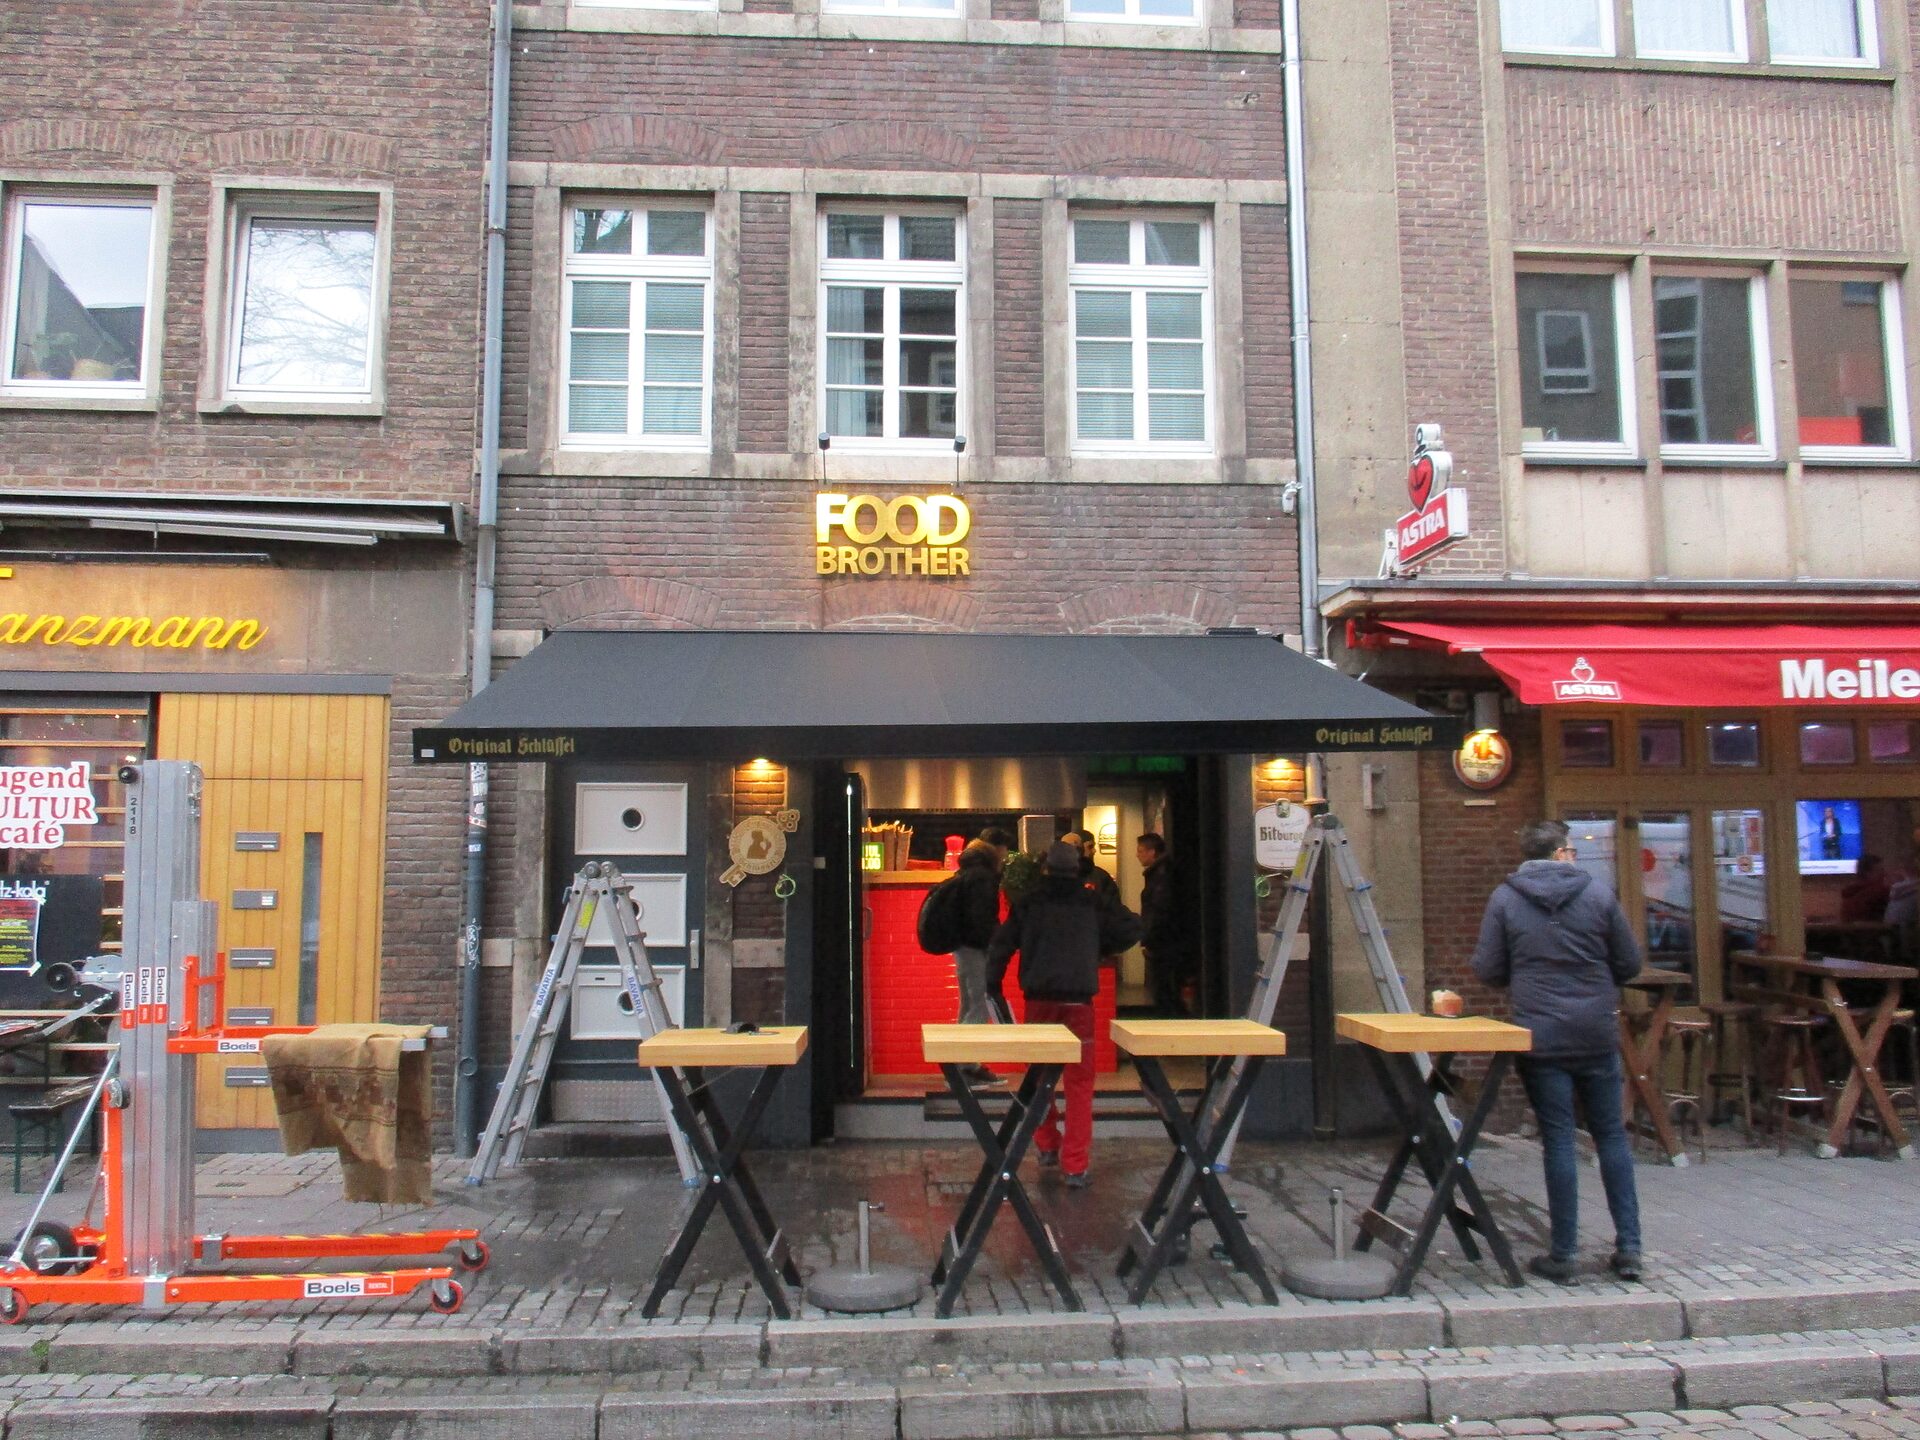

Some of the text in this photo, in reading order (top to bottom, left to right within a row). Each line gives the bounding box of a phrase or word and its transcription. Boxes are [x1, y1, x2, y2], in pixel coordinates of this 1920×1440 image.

[816, 493, 970, 546] FOOD
[1401, 507, 1446, 550] ASTRA
[816, 546, 970, 576] BROTHER
[1560, 684, 1616, 696] ASTRA
[1780, 658, 1920, 699] Meile
[449, 736, 512, 756] Original
[1315, 727, 1374, 745] Original
[0, 820, 60, 845] café
[129, 797, 138, 835] 2118
[124, 974, 134, 1010] Boels
[140, 969, 150, 1004] Boels
[156, 969, 166, 1003] Boels
[536, 968, 555, 1006] BAVARIA
[627, 976, 645, 1015] BAVARIA
[219, 1041, 257, 1051] Boels
[307, 1281, 361, 1295] Boels
